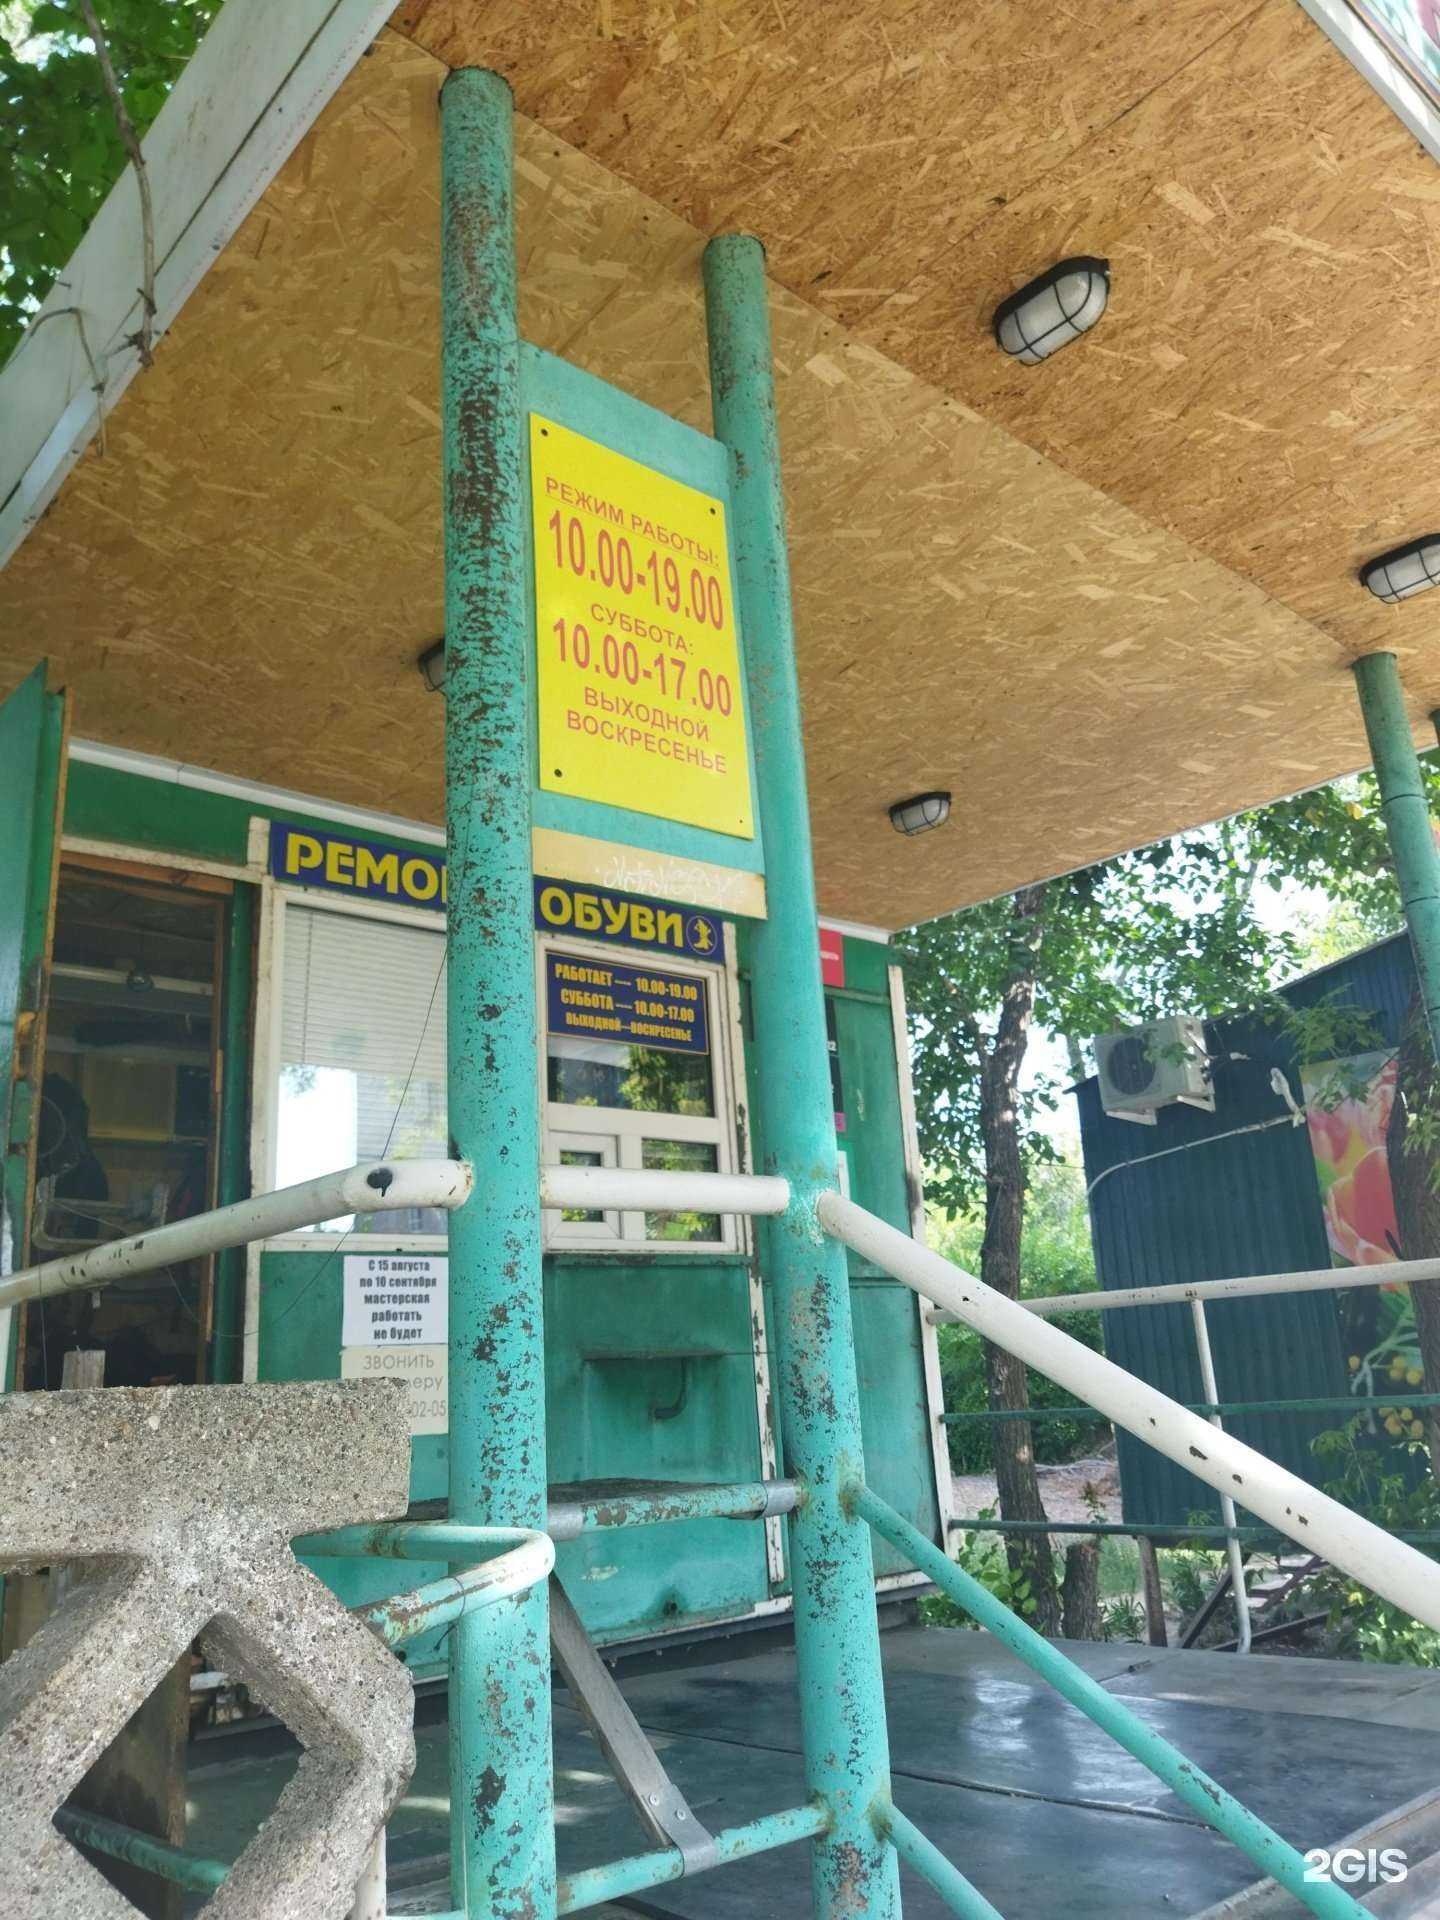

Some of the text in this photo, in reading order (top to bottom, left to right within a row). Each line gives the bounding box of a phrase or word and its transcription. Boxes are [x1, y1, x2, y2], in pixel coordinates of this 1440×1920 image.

[545, 476, 720, 568] РЕЖИМ РАБОТЫ:
[549, 509, 724, 631] 10.00-19.00
[590, 603, 694, 656] СУББОТА:
[553, 617, 732, 717] 10.00-17.00
[584, 686, 710, 743] ВЫХОДНОЙ
[567, 710, 727, 775] ВОСКРЕСЕНЬЕ
[285, 832, 685, 949] РЕМО ОБУВИ
[554, 963, 613, 987] РАБОТАЕТ
[635, 977, 698, 1001] 10.00-19.00
[560, 988, 614, 1011] СУББОТА
[634, 1000, 695, 1023] 10.00-17.00
[360, 1276, 437, 1289] по 10 сентября
[378, 1259, 388, 1272] 15
[391, 1260, 430, 1273] августа
[364, 1293, 430, 1305] мастерская
[371, 1310, 422, 1324] работать
[373, 1327, 422, 1341] не будет
[363, 1354, 434, 1370] ЗВОНИТЬ
